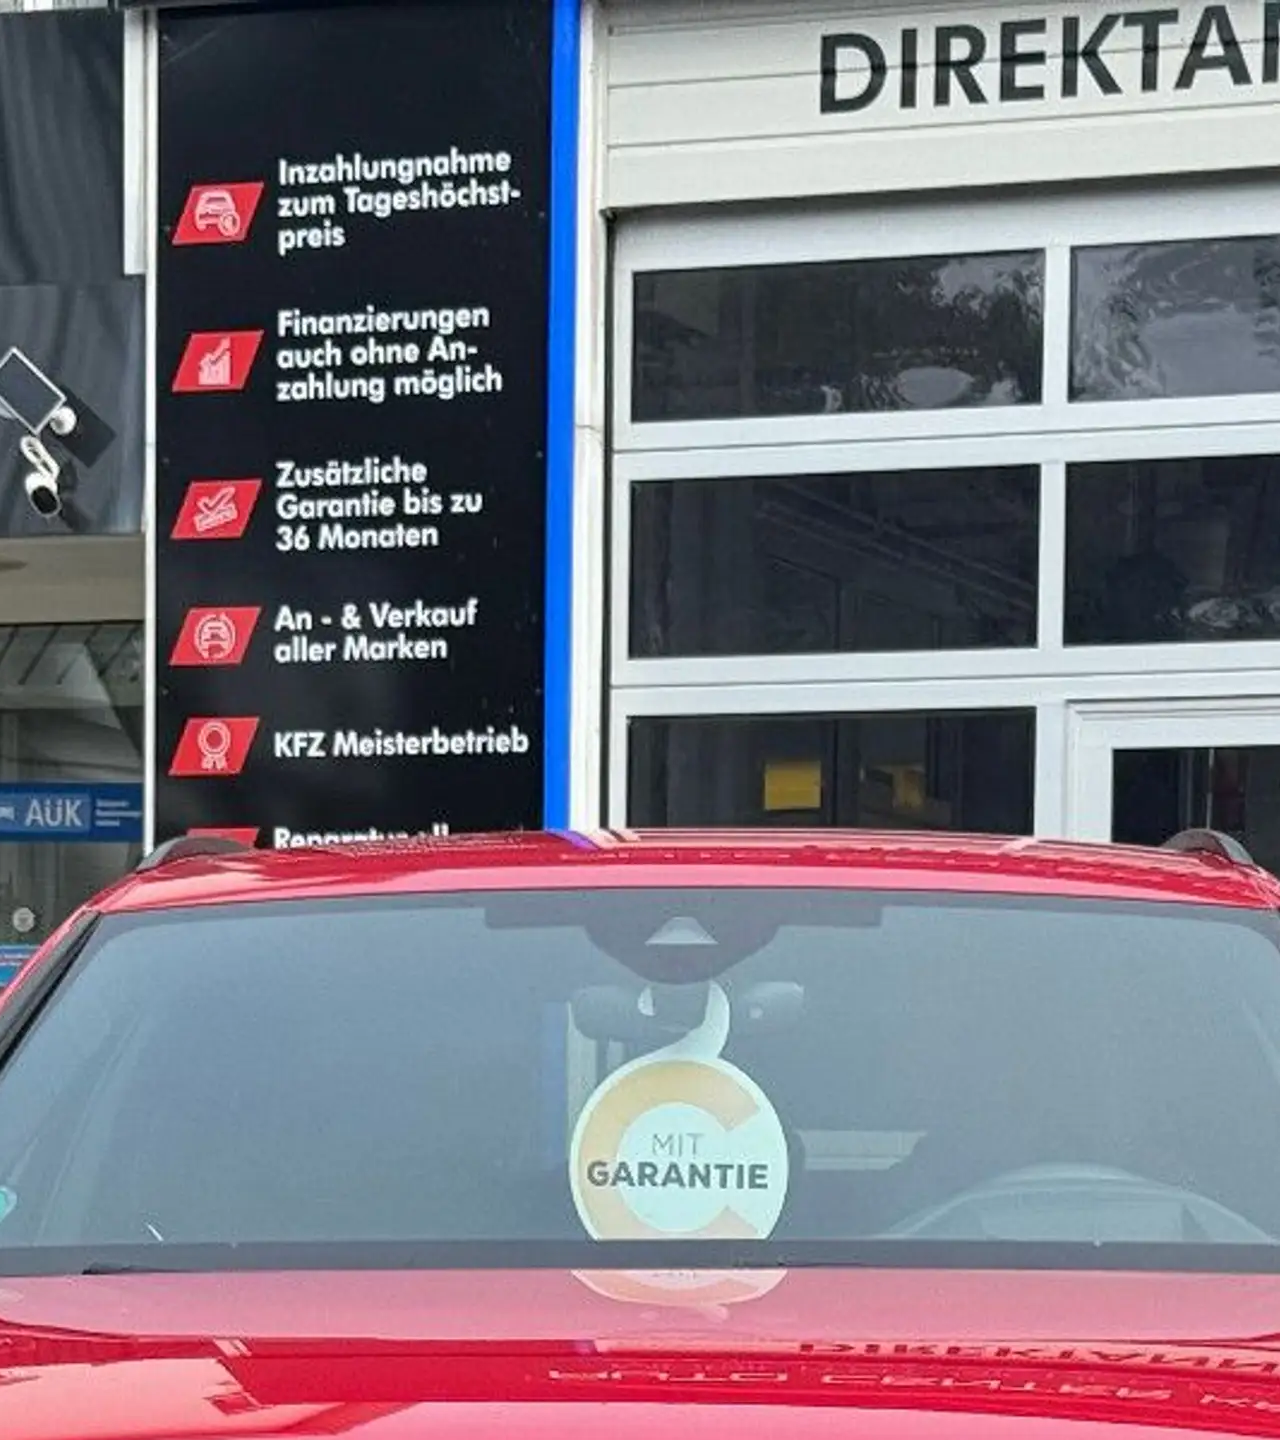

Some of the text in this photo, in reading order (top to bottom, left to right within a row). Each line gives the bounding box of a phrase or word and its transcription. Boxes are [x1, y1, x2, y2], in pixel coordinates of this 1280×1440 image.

[278, 146, 512, 185] Inzahlungnahme
[277, 179, 522, 218] zum Tageshöchst-
[278, 219, 346, 256] preis
[277, 305, 490, 337] Finanzierungen
[276, 335, 478, 369] auch ohne An-
[276, 363, 503, 404] zahlung möglich
[275, 456, 429, 488] Zusätzliche
[276, 487, 483, 520] Garantie bis zu
[275, 523, 438, 552] 36 Monaten
[274, 605, 313, 632] An
[340, 603, 361, 630] &
[368, 597, 478, 629] Verkauf
[274, 632, 447, 664] aller Marken
[274, 725, 529, 758] KFZ Meisterbetrieb
[24, 798, 82, 827] AÜK
[652, 1133, 704, 1158] MIT
[586, 1159, 769, 1190] GARANTIE
